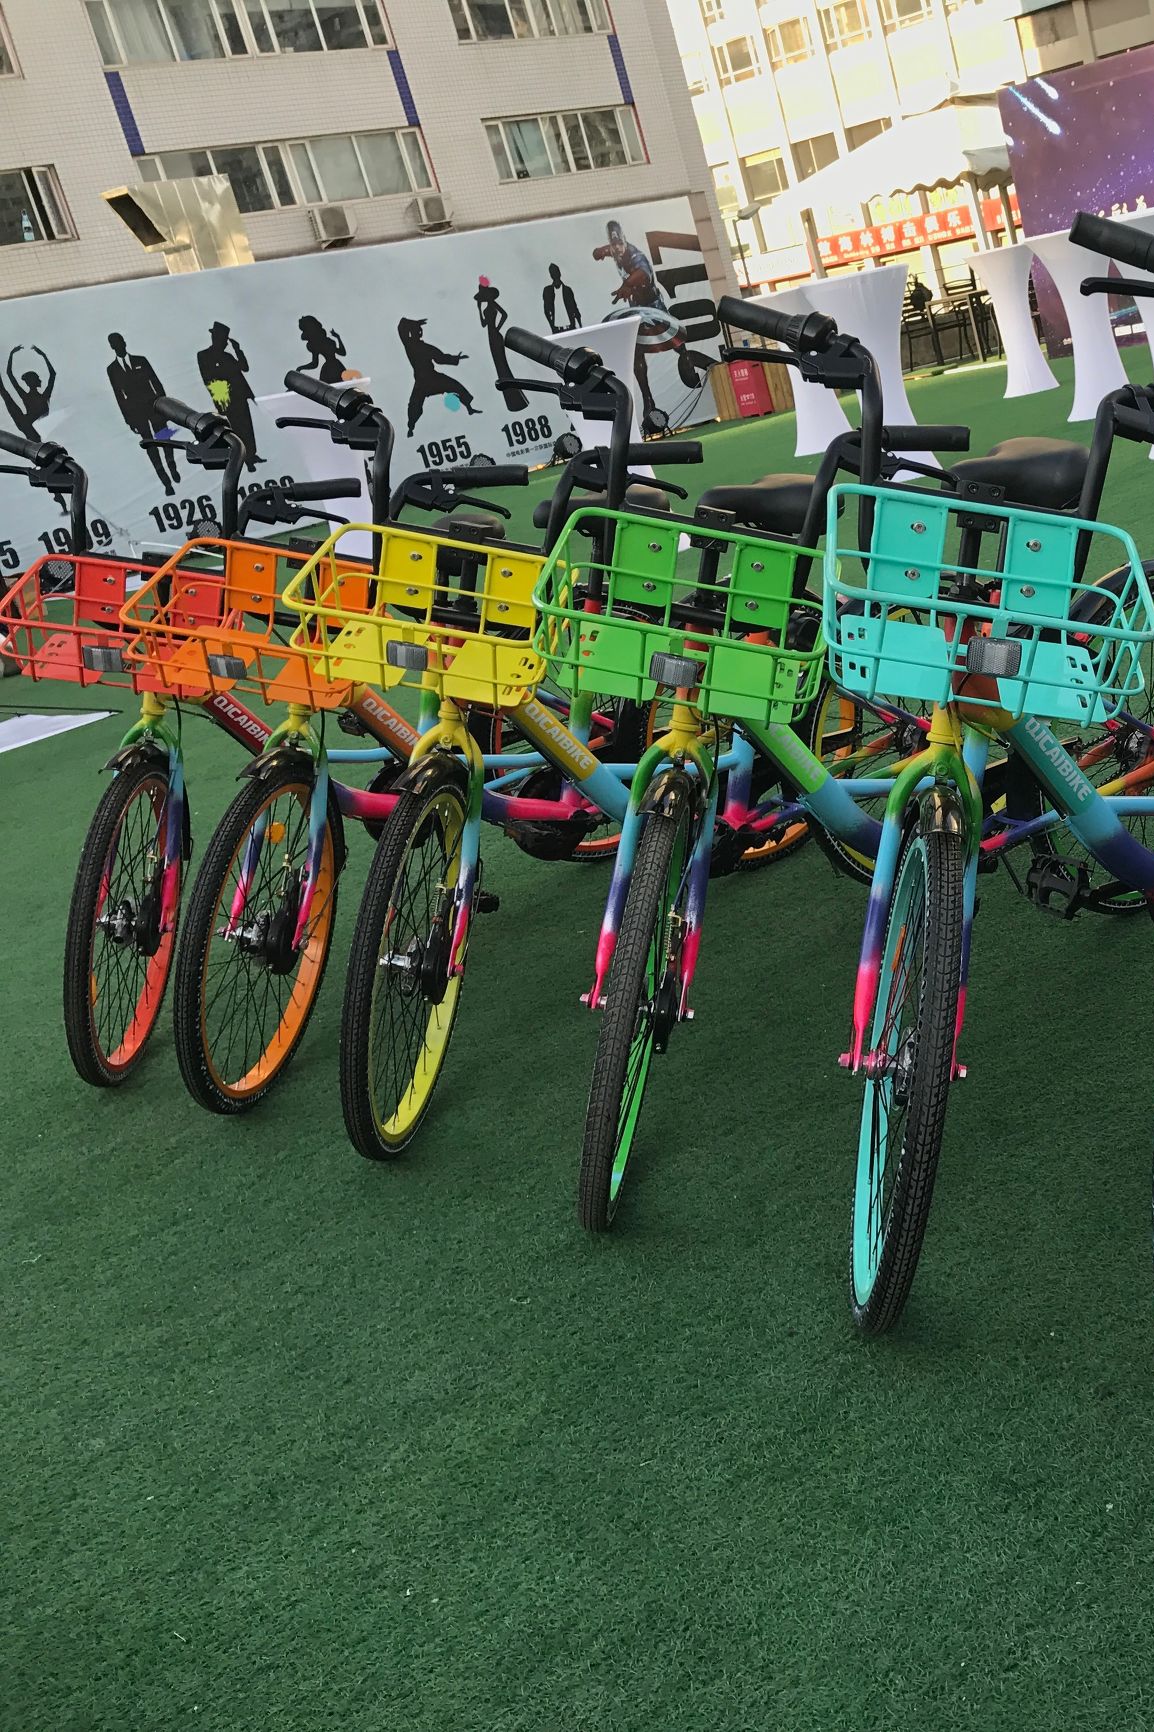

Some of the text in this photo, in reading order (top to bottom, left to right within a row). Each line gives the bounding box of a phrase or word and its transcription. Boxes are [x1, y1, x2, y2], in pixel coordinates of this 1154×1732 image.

[416, 434, 473, 469] 1955
[501, 414, 553, 447] 1988
[149, 494, 218, 533] 1926
[37, 518, 112, 556] 199
[213, 695, 271, 745] QICAIBIK
[362, 697, 420, 746] QICAIBI
[524, 703, 593, 769] QICAIBIKE
[1024, 716, 1092, 802] QICAIBIKE
